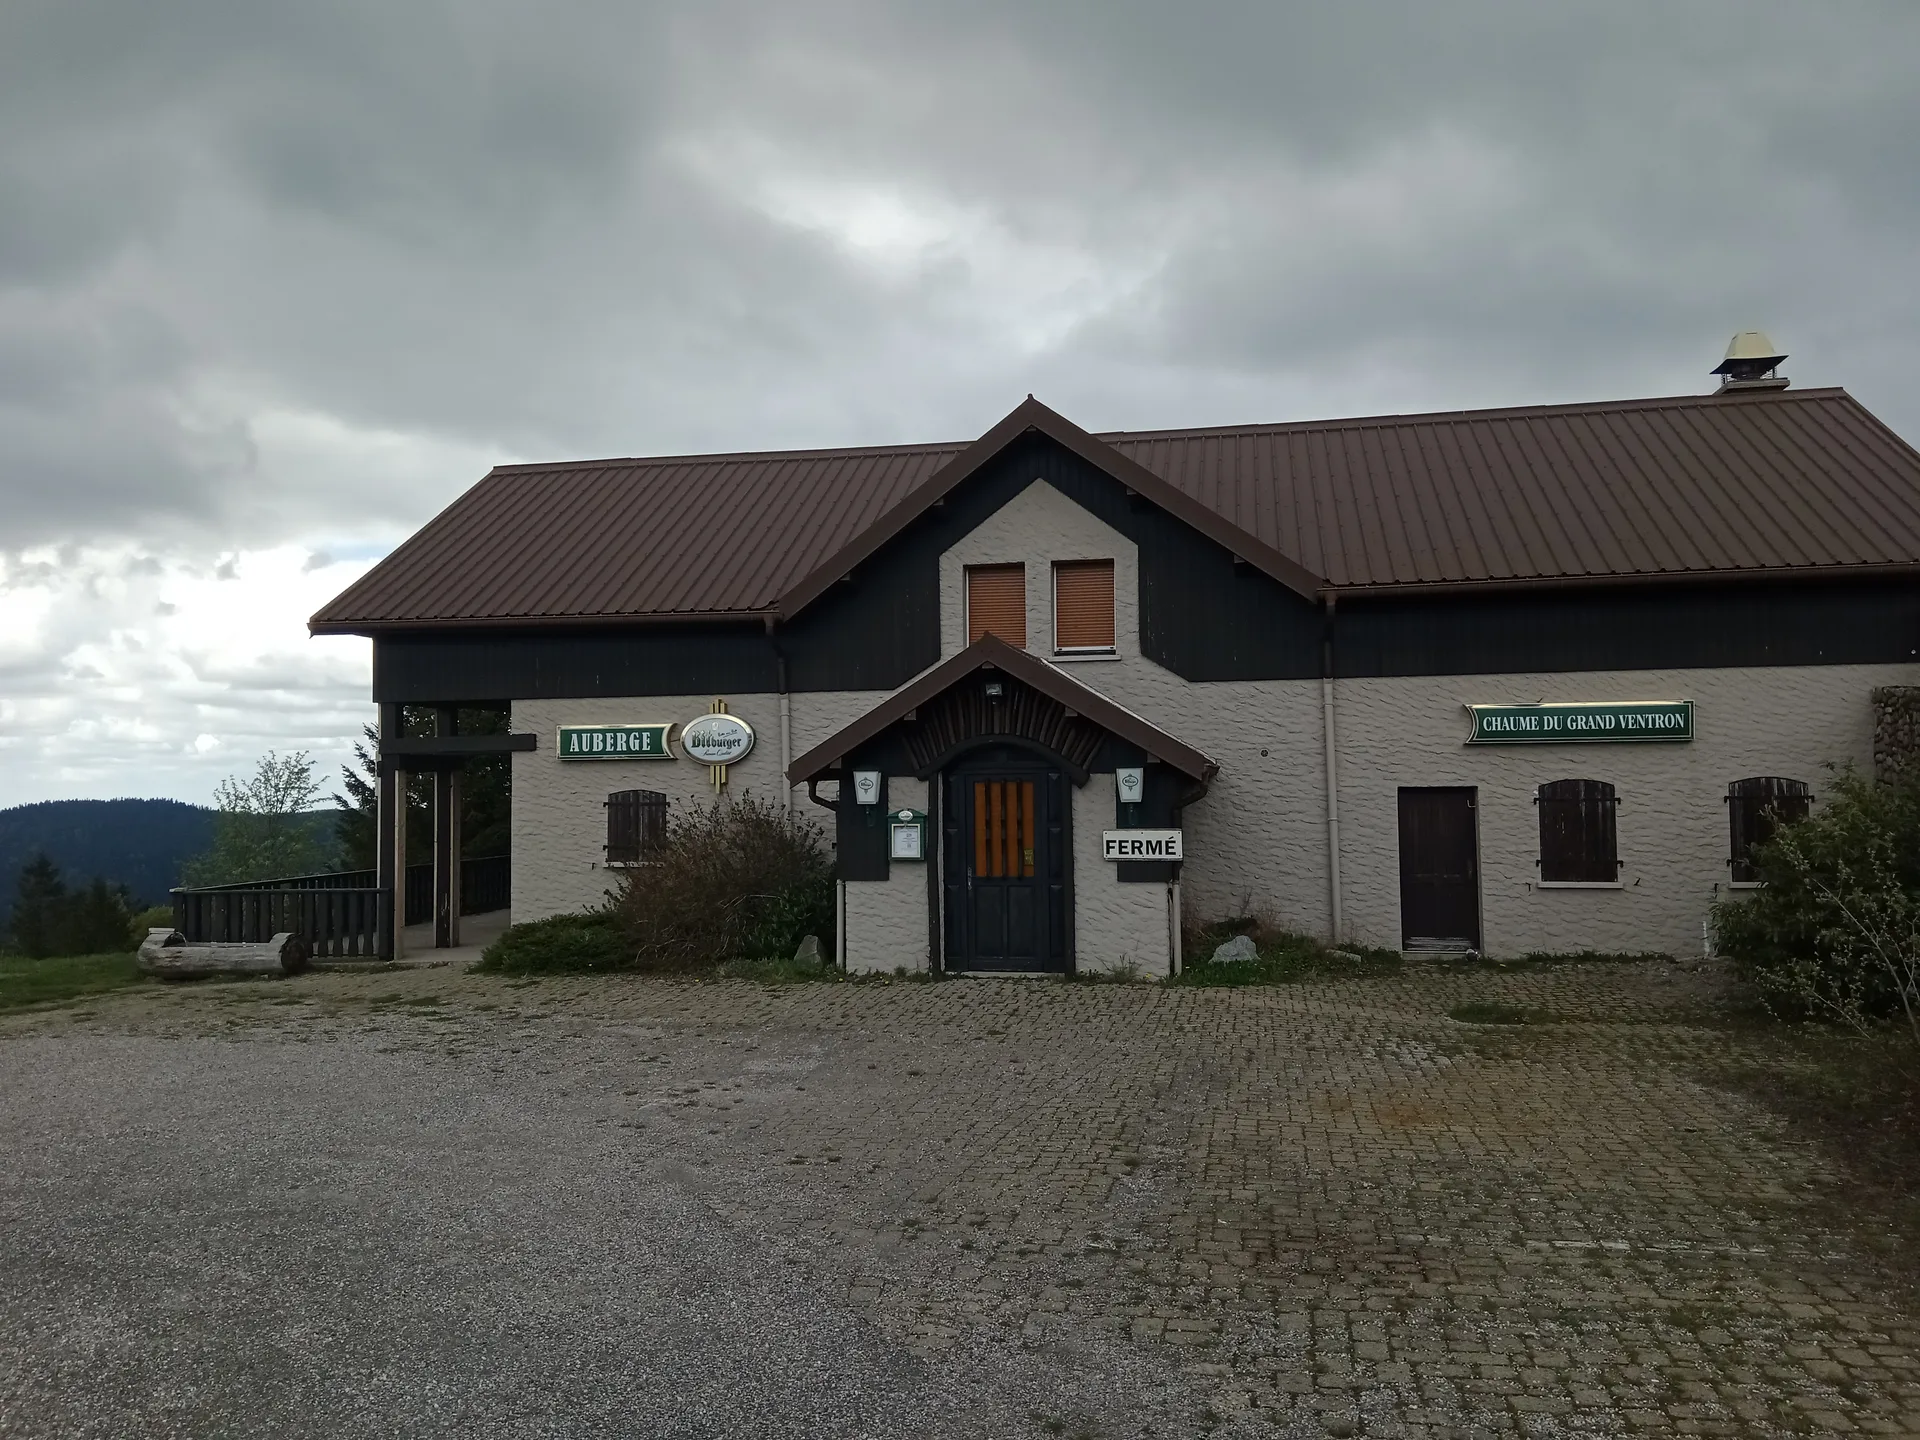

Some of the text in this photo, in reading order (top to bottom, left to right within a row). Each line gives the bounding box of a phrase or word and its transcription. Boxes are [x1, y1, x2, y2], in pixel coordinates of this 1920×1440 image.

[1483, 713, 1685, 732] CHAUME DU GRAND VENTRON
[570, 731, 651, 752] AUBERGE
[1105, 836, 1177, 856] FERMÉ
